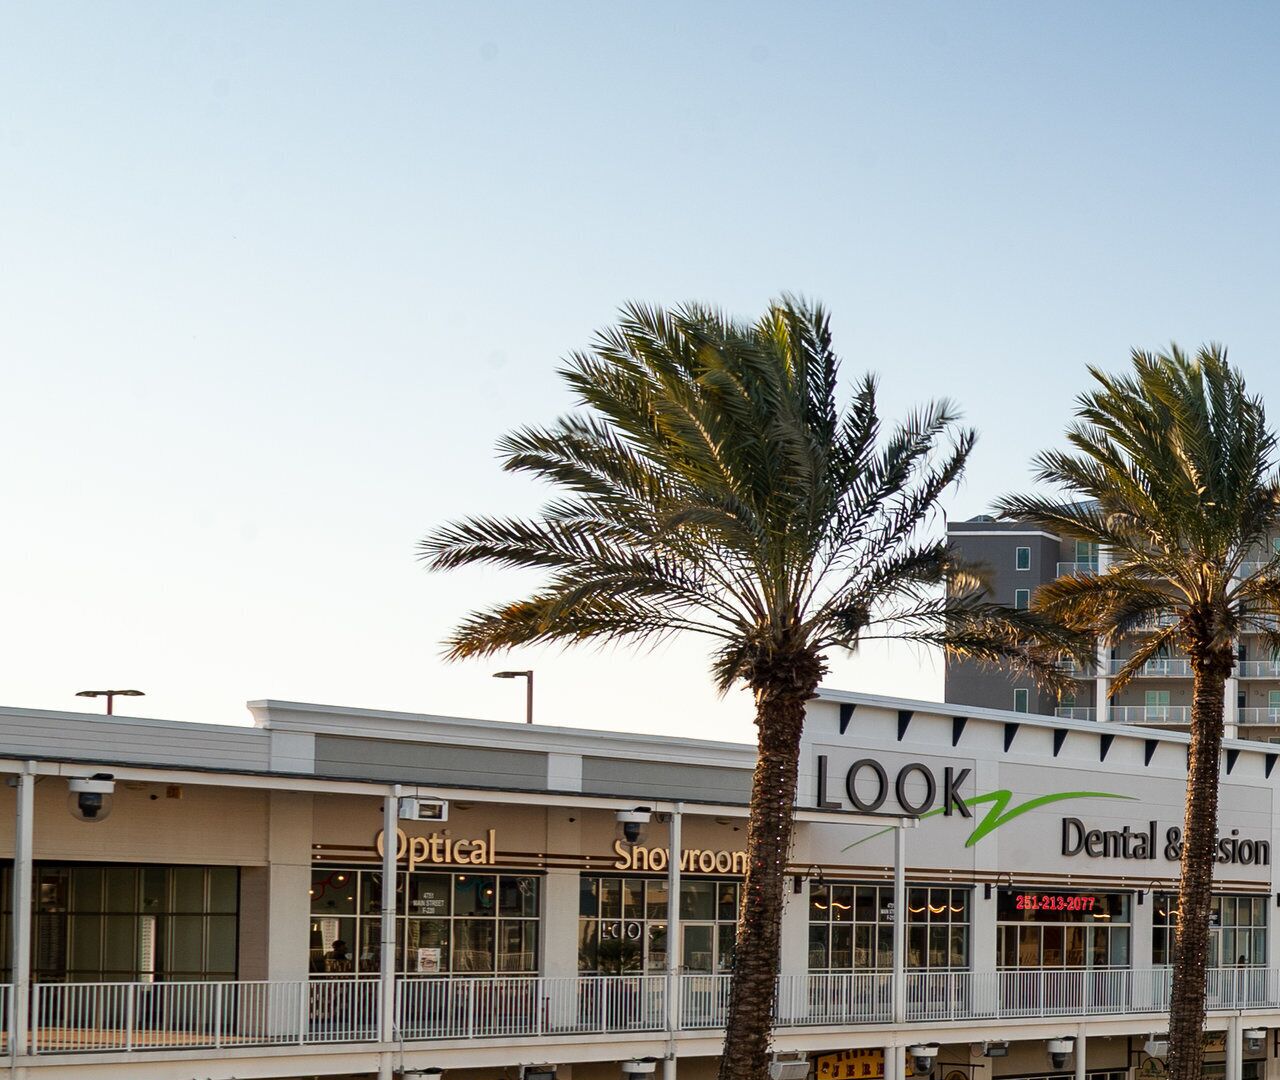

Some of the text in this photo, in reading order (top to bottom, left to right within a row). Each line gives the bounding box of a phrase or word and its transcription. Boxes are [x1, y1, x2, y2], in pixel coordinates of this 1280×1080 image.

[816, 753, 974, 819] LOOK
[377, 827, 496, 872] Optical
[1061, 816, 1158, 861] Dental
[1212, 828, 1271, 866] ision
[1015, 894, 1096, 911] 251-213-2077
